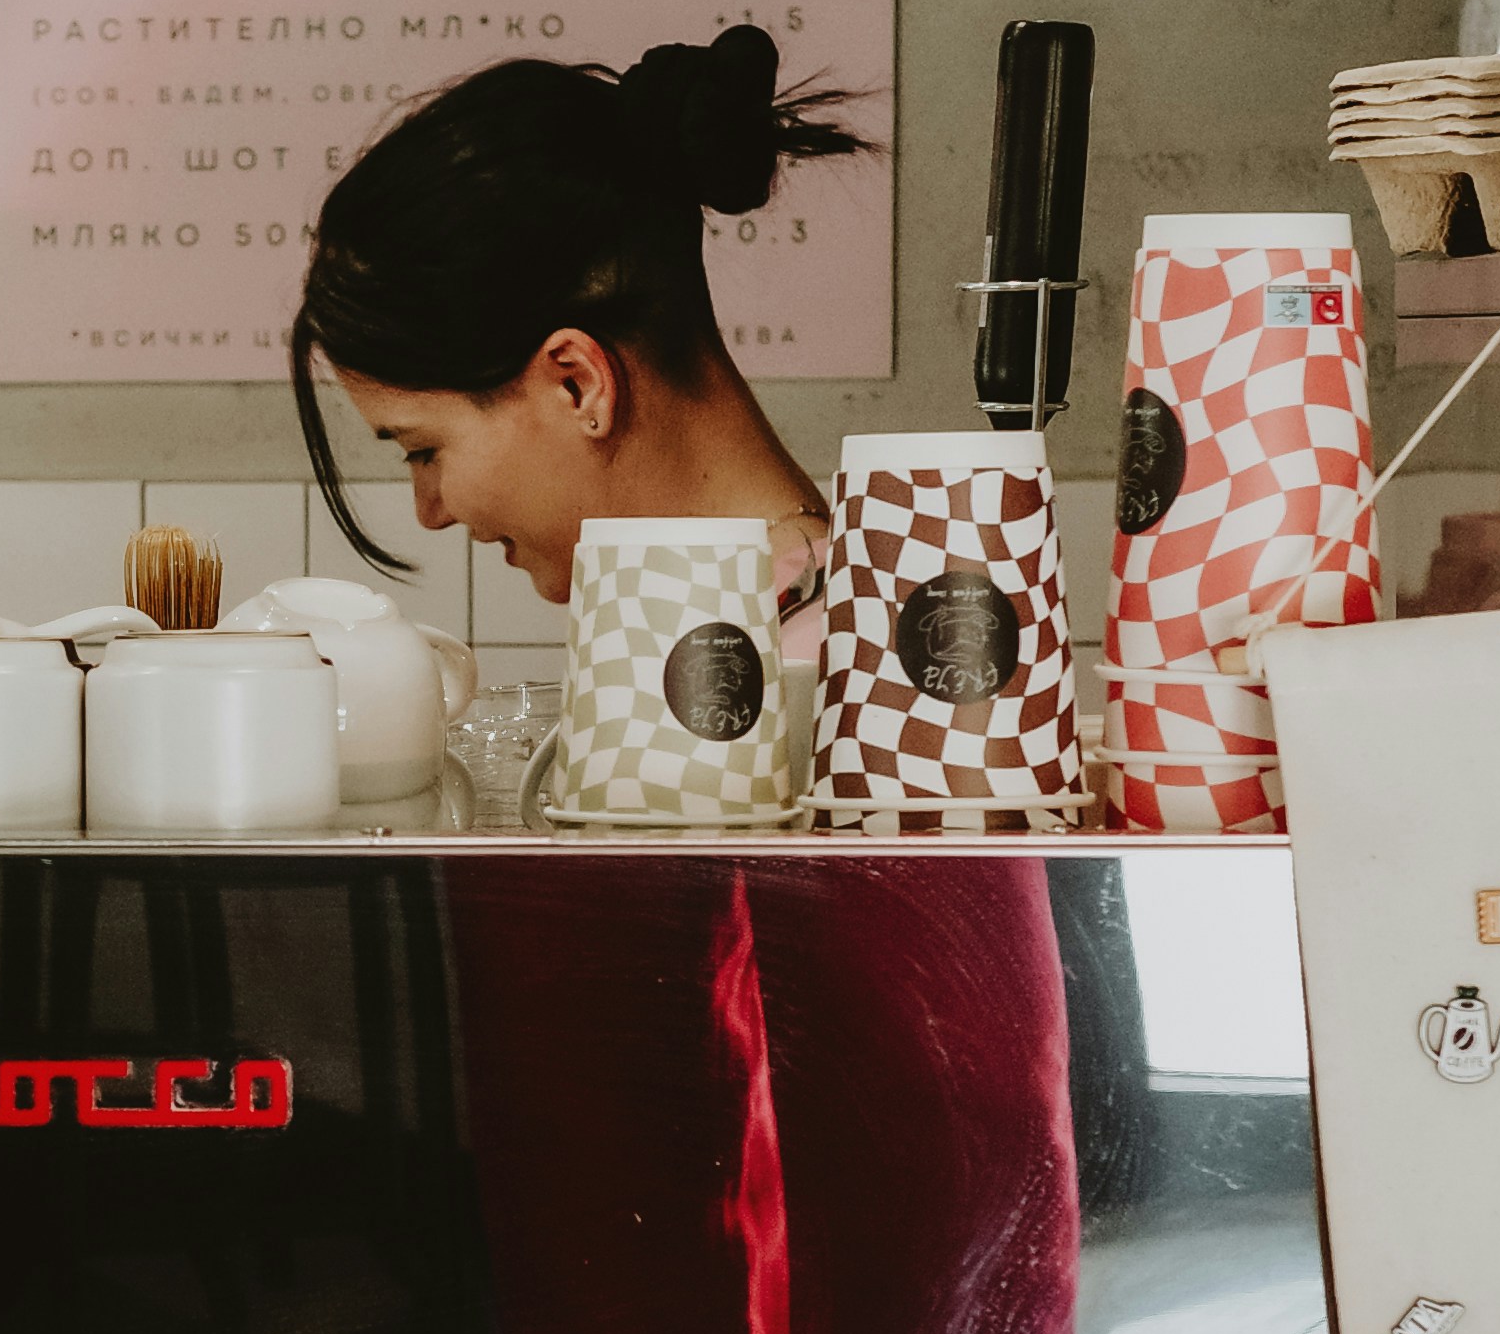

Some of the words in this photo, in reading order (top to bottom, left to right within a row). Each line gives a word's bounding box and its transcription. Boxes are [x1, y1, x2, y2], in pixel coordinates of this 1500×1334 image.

[33, 15, 366, 43] РАСТИТЕЛНО
[184, 146, 289, 173] ШОТ
[32, 222, 200, 248] МЛЯКО
